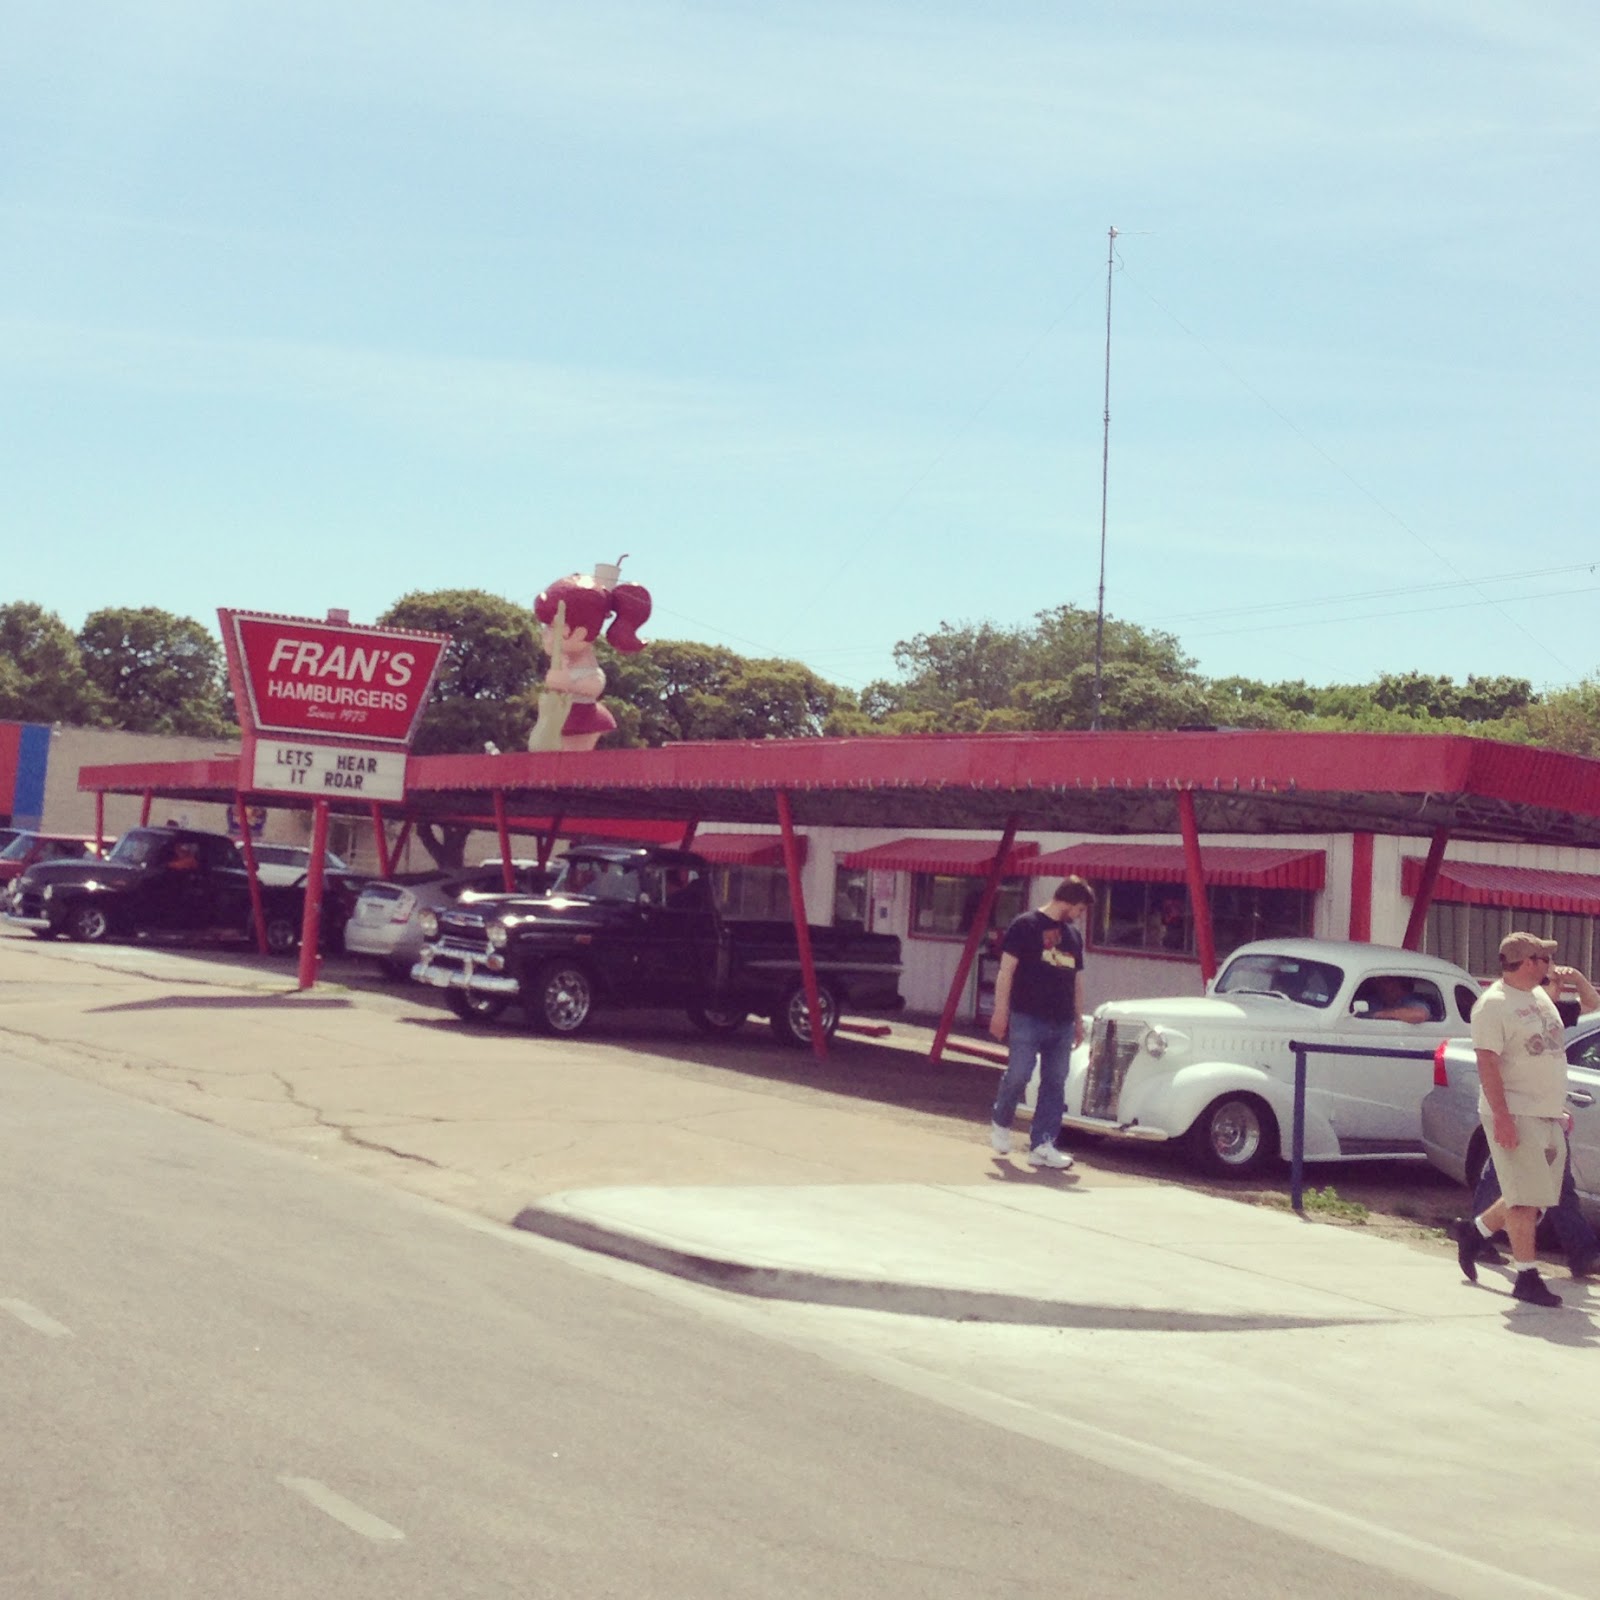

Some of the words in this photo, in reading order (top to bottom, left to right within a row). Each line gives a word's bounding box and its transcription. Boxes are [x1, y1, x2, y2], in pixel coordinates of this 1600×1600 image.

[268, 638, 415, 686] FRAN'S
[268, 680, 407, 711] HAMBURGERS
[277, 750, 313, 767] LETS
[337, 755, 377, 773] HEAR
[291, 769, 306, 784] IT
[324, 771, 363, 790] ROAR
